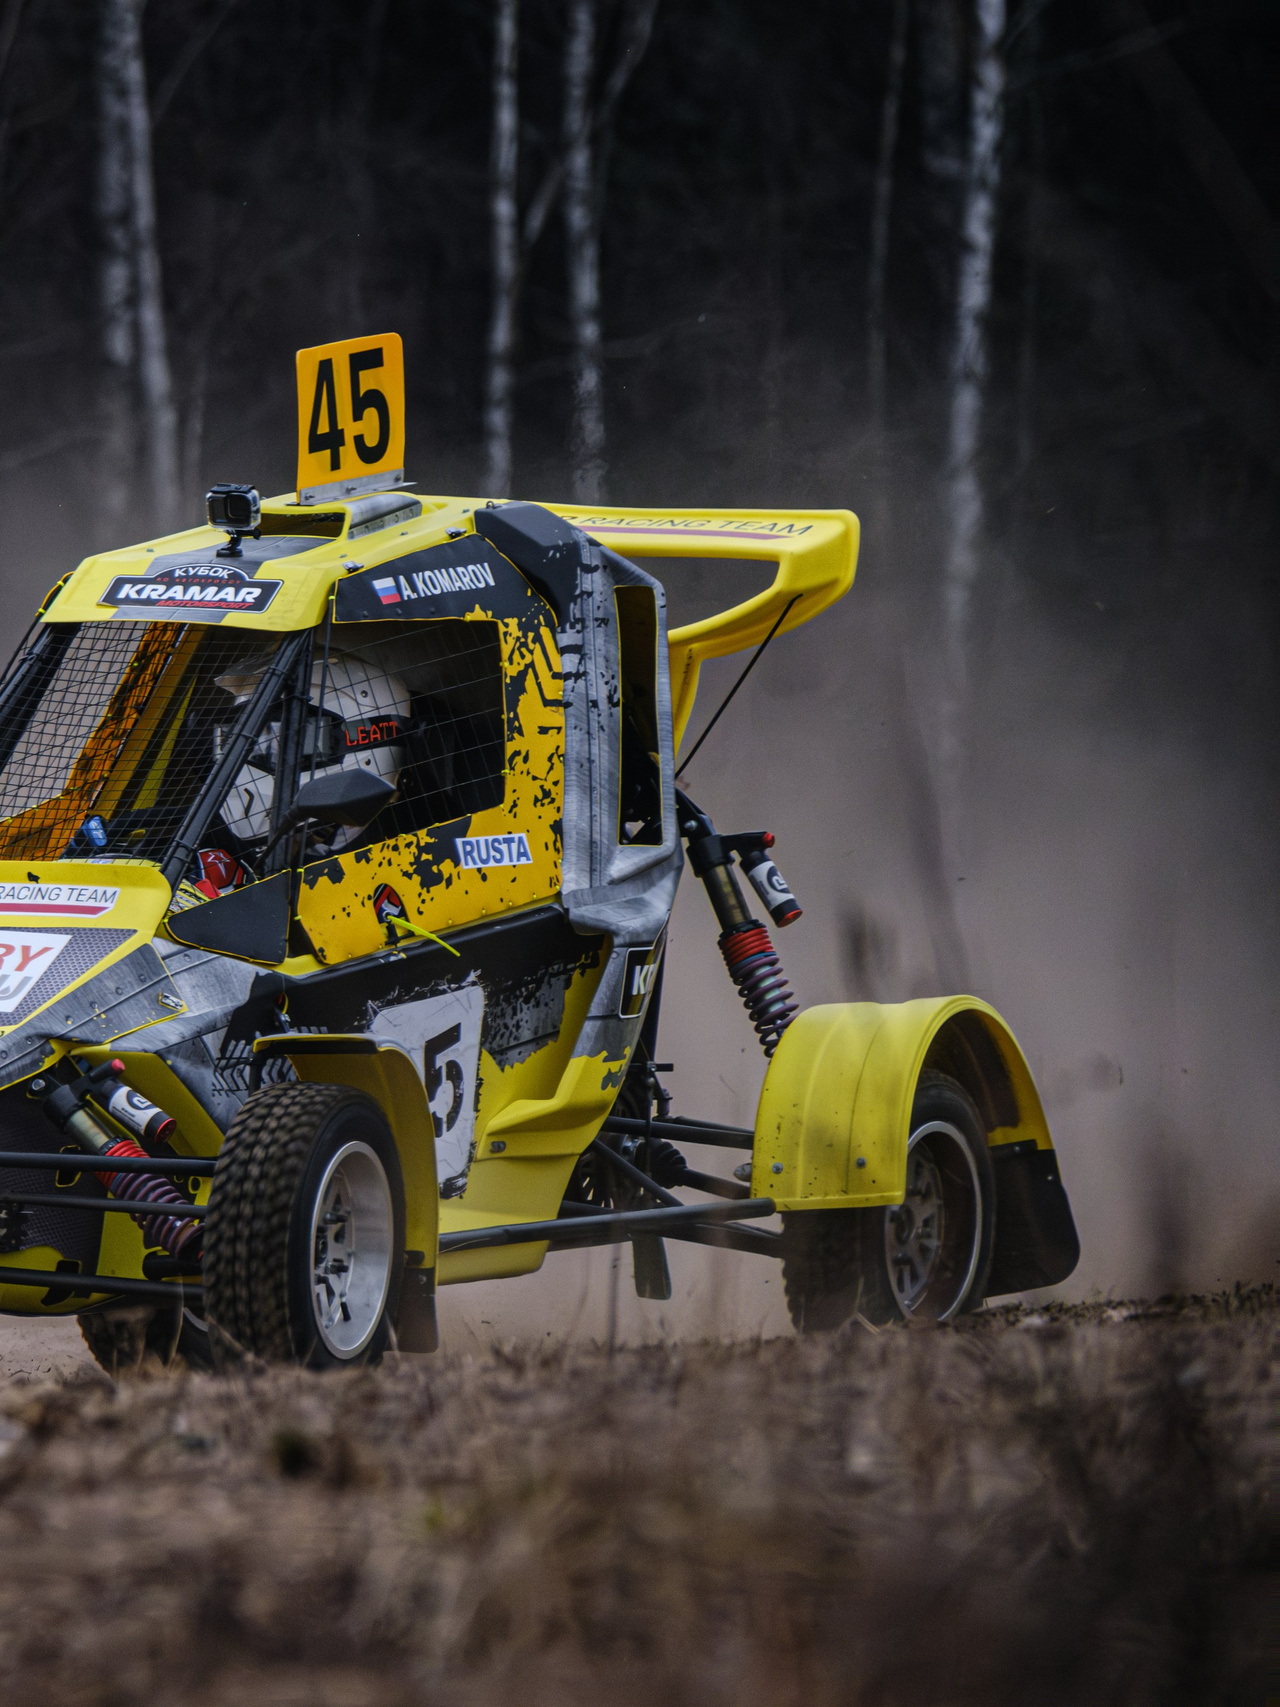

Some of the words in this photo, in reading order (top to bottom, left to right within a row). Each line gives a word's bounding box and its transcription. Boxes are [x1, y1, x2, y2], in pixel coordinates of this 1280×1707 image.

[308, 347, 390, 472] 45
[579, 516, 710, 528] RACING
[719, 520, 814, 535] TEAM
[174, 566, 234, 579] КУБОК
[117, 583, 262, 603] KRAMAR
[155, 600, 254, 610] MOTORSPORT
[345, 721, 398, 746] LEATT
[462, 836, 532, 866] RUSTA
[67, 887, 118, 904] TEAM
